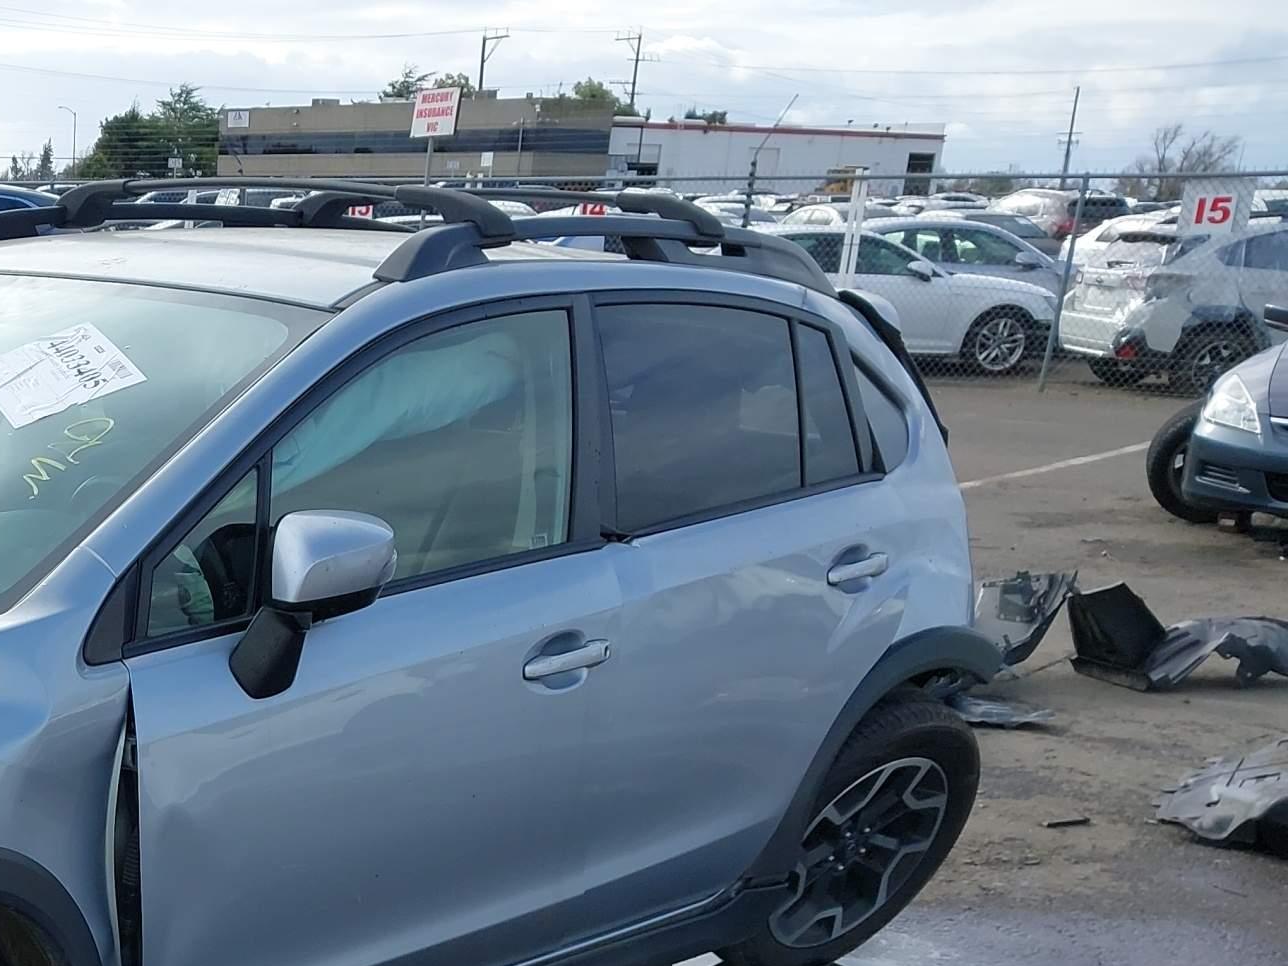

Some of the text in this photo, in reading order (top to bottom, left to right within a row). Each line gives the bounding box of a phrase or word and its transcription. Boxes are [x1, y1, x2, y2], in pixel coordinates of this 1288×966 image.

[422, 92, 454, 104] MERCURY
[416, 106, 453, 118] INSURANCE
[1194, 196, 1233, 224] 15
[47, 339, 109, 389] 44033405
